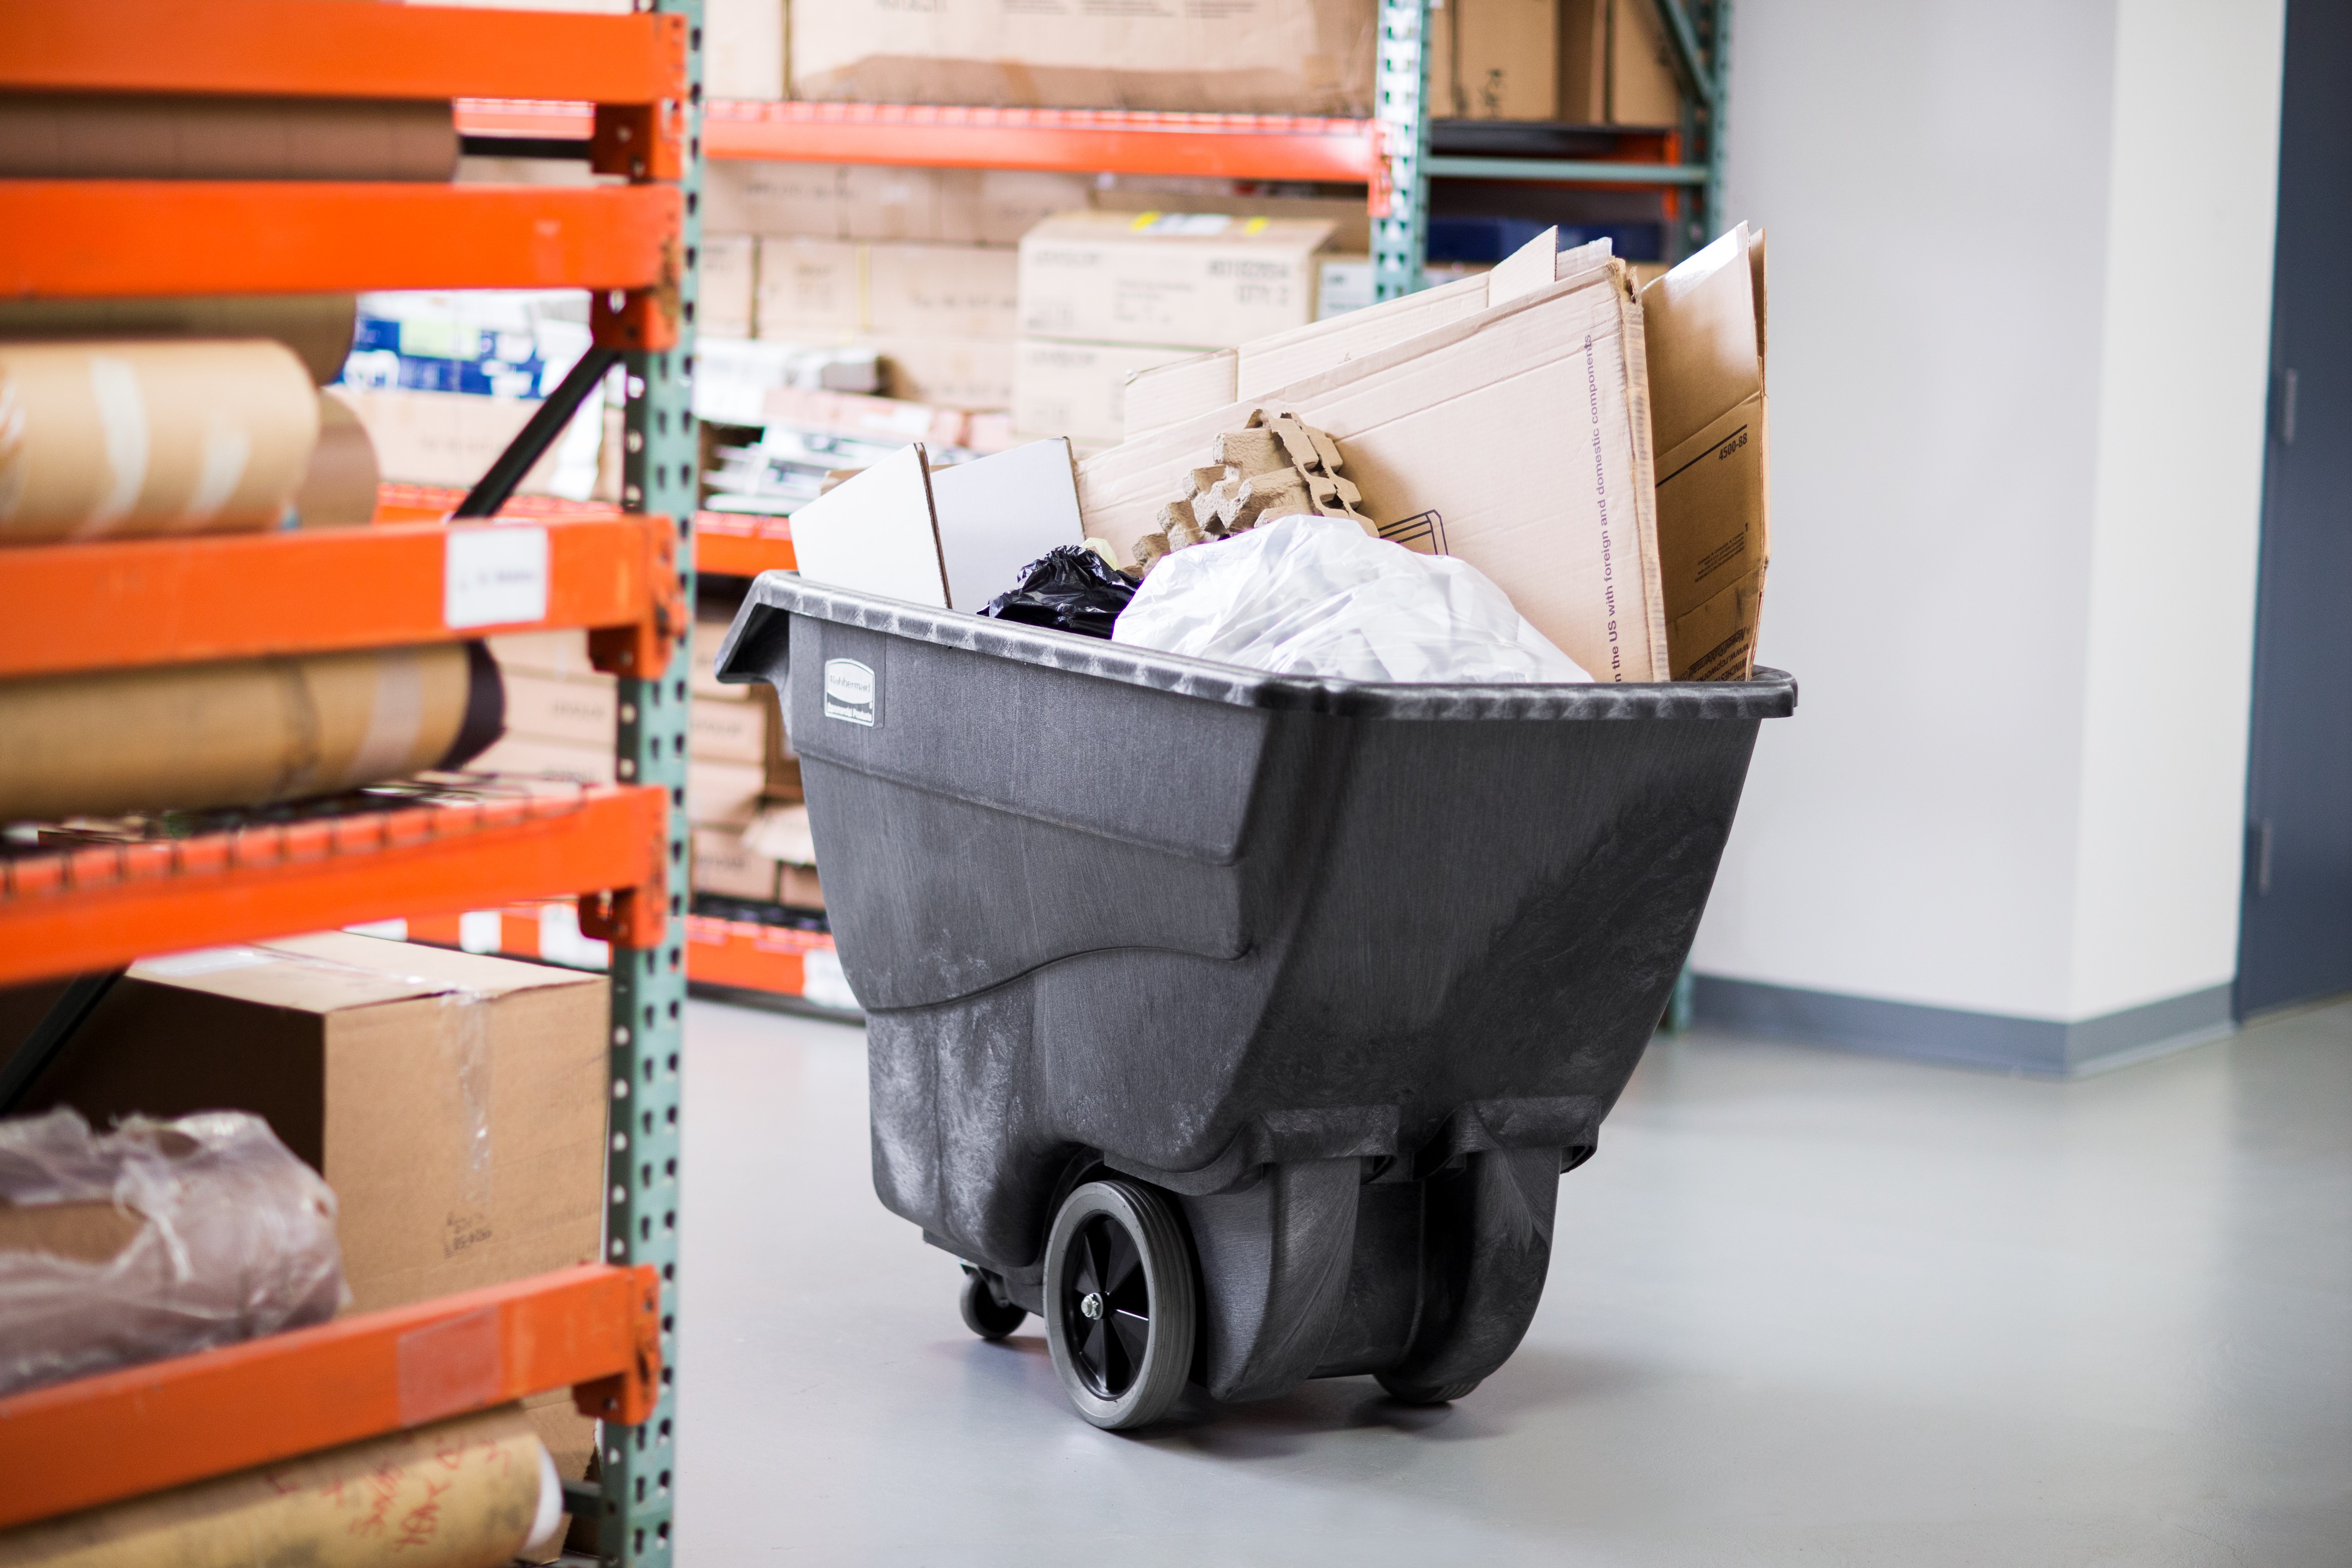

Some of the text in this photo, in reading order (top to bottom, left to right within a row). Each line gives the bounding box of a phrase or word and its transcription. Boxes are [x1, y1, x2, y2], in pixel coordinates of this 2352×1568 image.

[1584, 334, 1622, 682] n the US with foreign and domestic components
[1719, 433, 1747, 461] 4500-88
